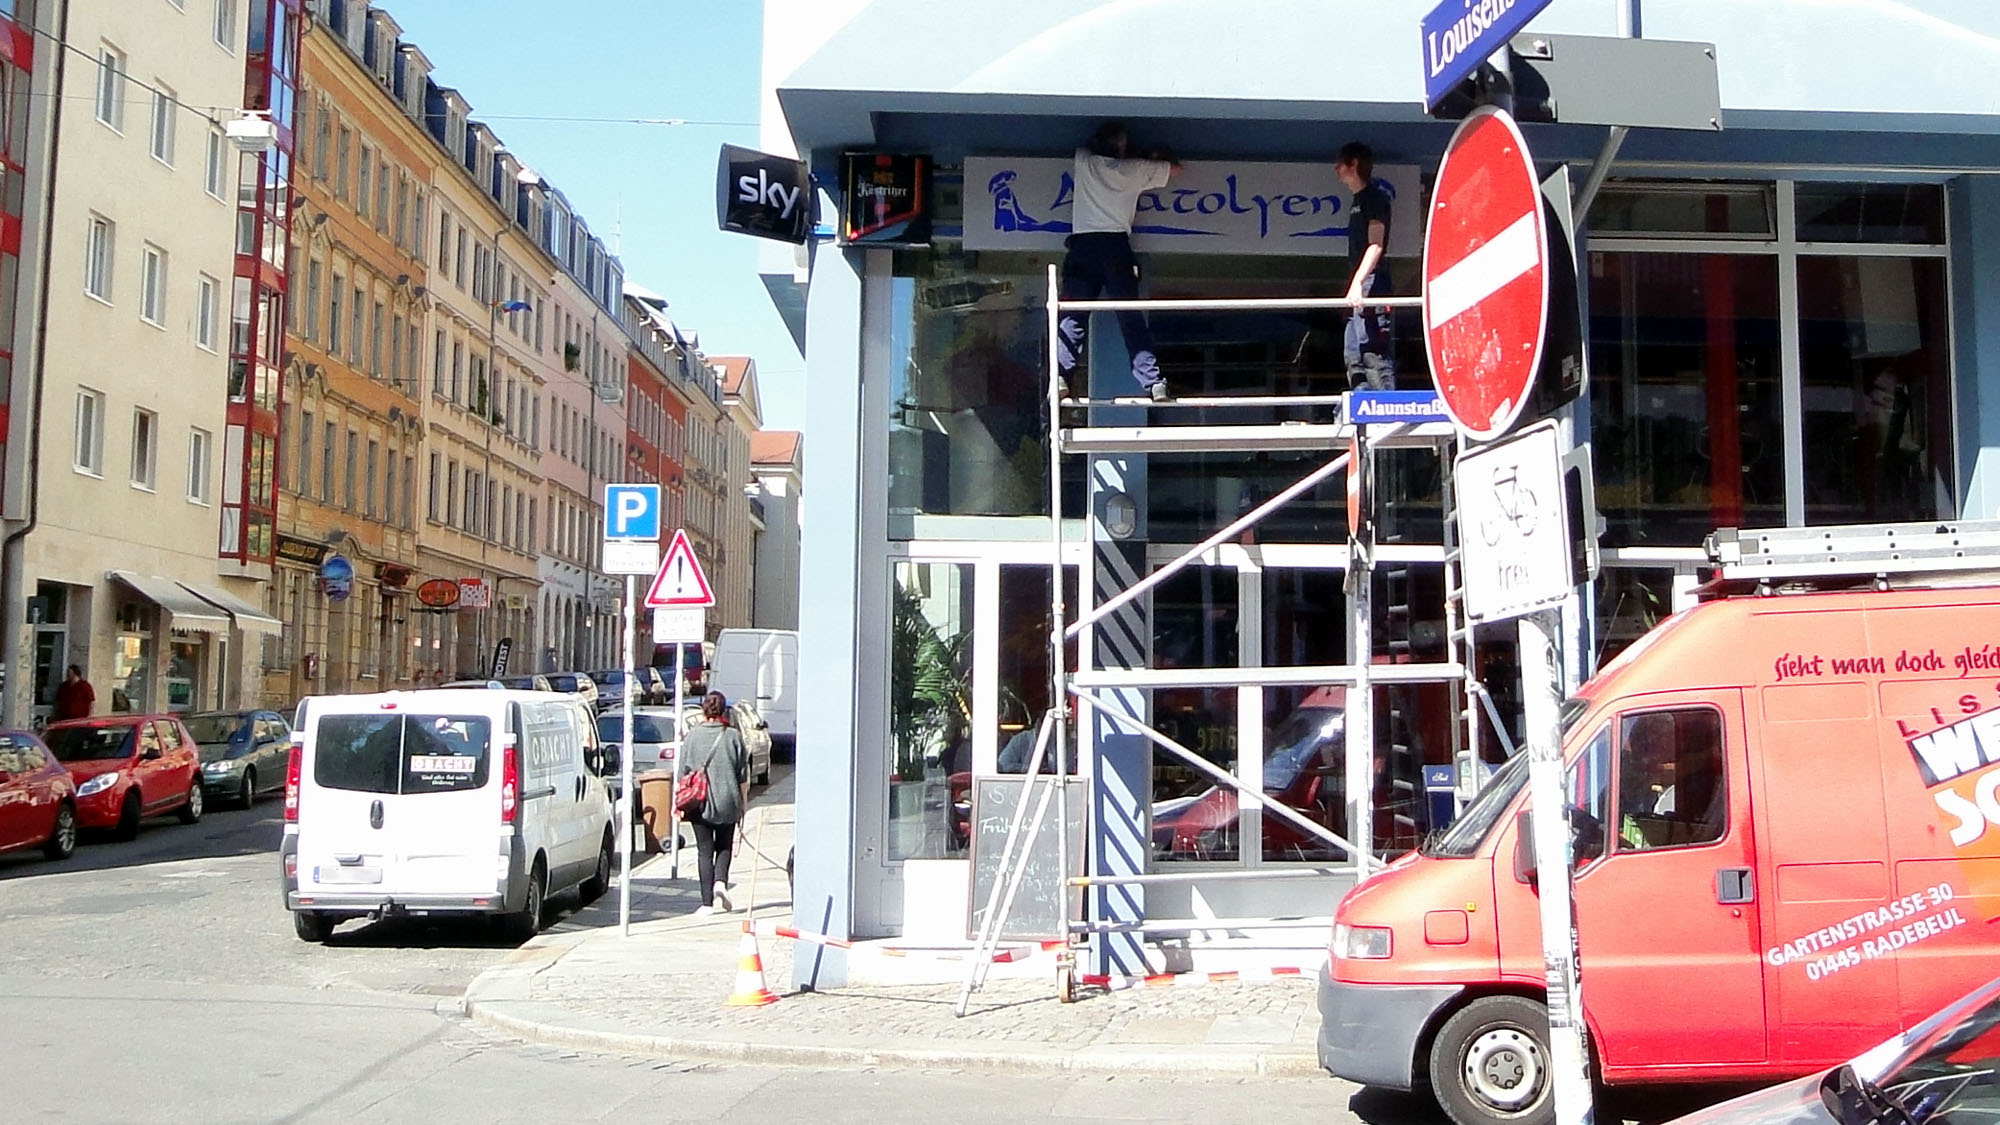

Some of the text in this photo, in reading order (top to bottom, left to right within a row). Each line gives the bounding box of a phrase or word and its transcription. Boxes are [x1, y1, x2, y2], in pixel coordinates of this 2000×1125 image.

[738, 168, 800, 219] sky
[1048, 171, 1342, 239] Aatolyen
[617, 491, 648, 533] P
[1498, 551, 1530, 592] frei
[1775, 652, 1824, 682] sieht
[1831, 656, 1886, 675] man
[1895, 648, 1946, 673] doch
[1896, 682, 2000, 738] LIS
[532, 734, 571, 766] OBACHT
[1767, 883, 1954, 966] GARTENSTRASSE 30
[1806, 907, 1967, 980] 01445 RADEBEUL
